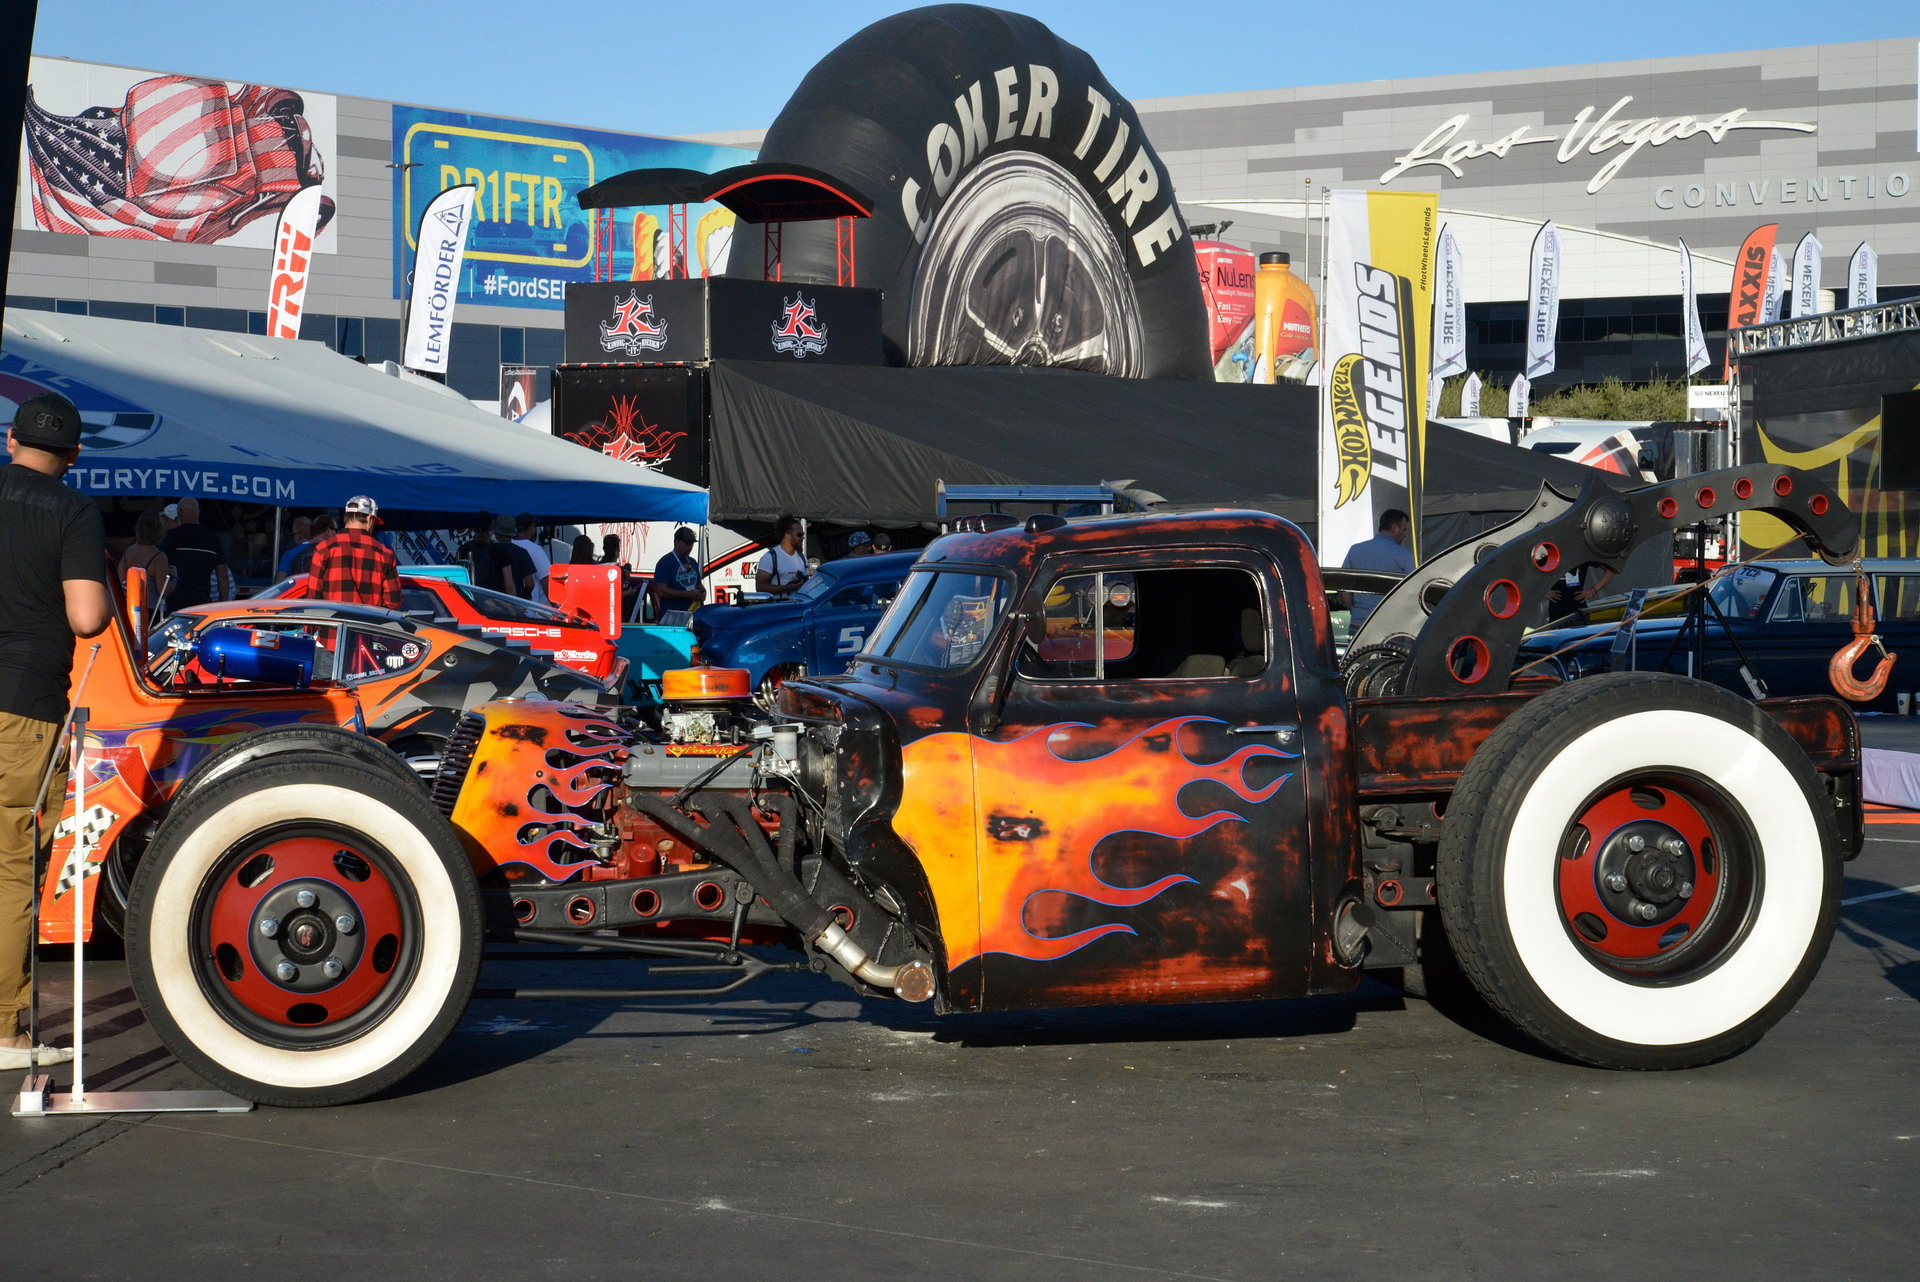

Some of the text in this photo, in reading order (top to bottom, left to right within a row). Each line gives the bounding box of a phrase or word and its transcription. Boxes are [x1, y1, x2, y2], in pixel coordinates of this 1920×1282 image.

[901, 63, 1183, 268] COKER TIRE
[1379, 95, 1818, 195] Las Vegas
[1654, 171, 1912, 210] CONVENTIO
[483, 274, 567, 301] #FordSE
[1420, 206, 1432, 292] #HotWheelsLegends
[425, 239, 458, 365] LEMFÖRDER
[1354, 261, 1409, 490] LEGENDS
